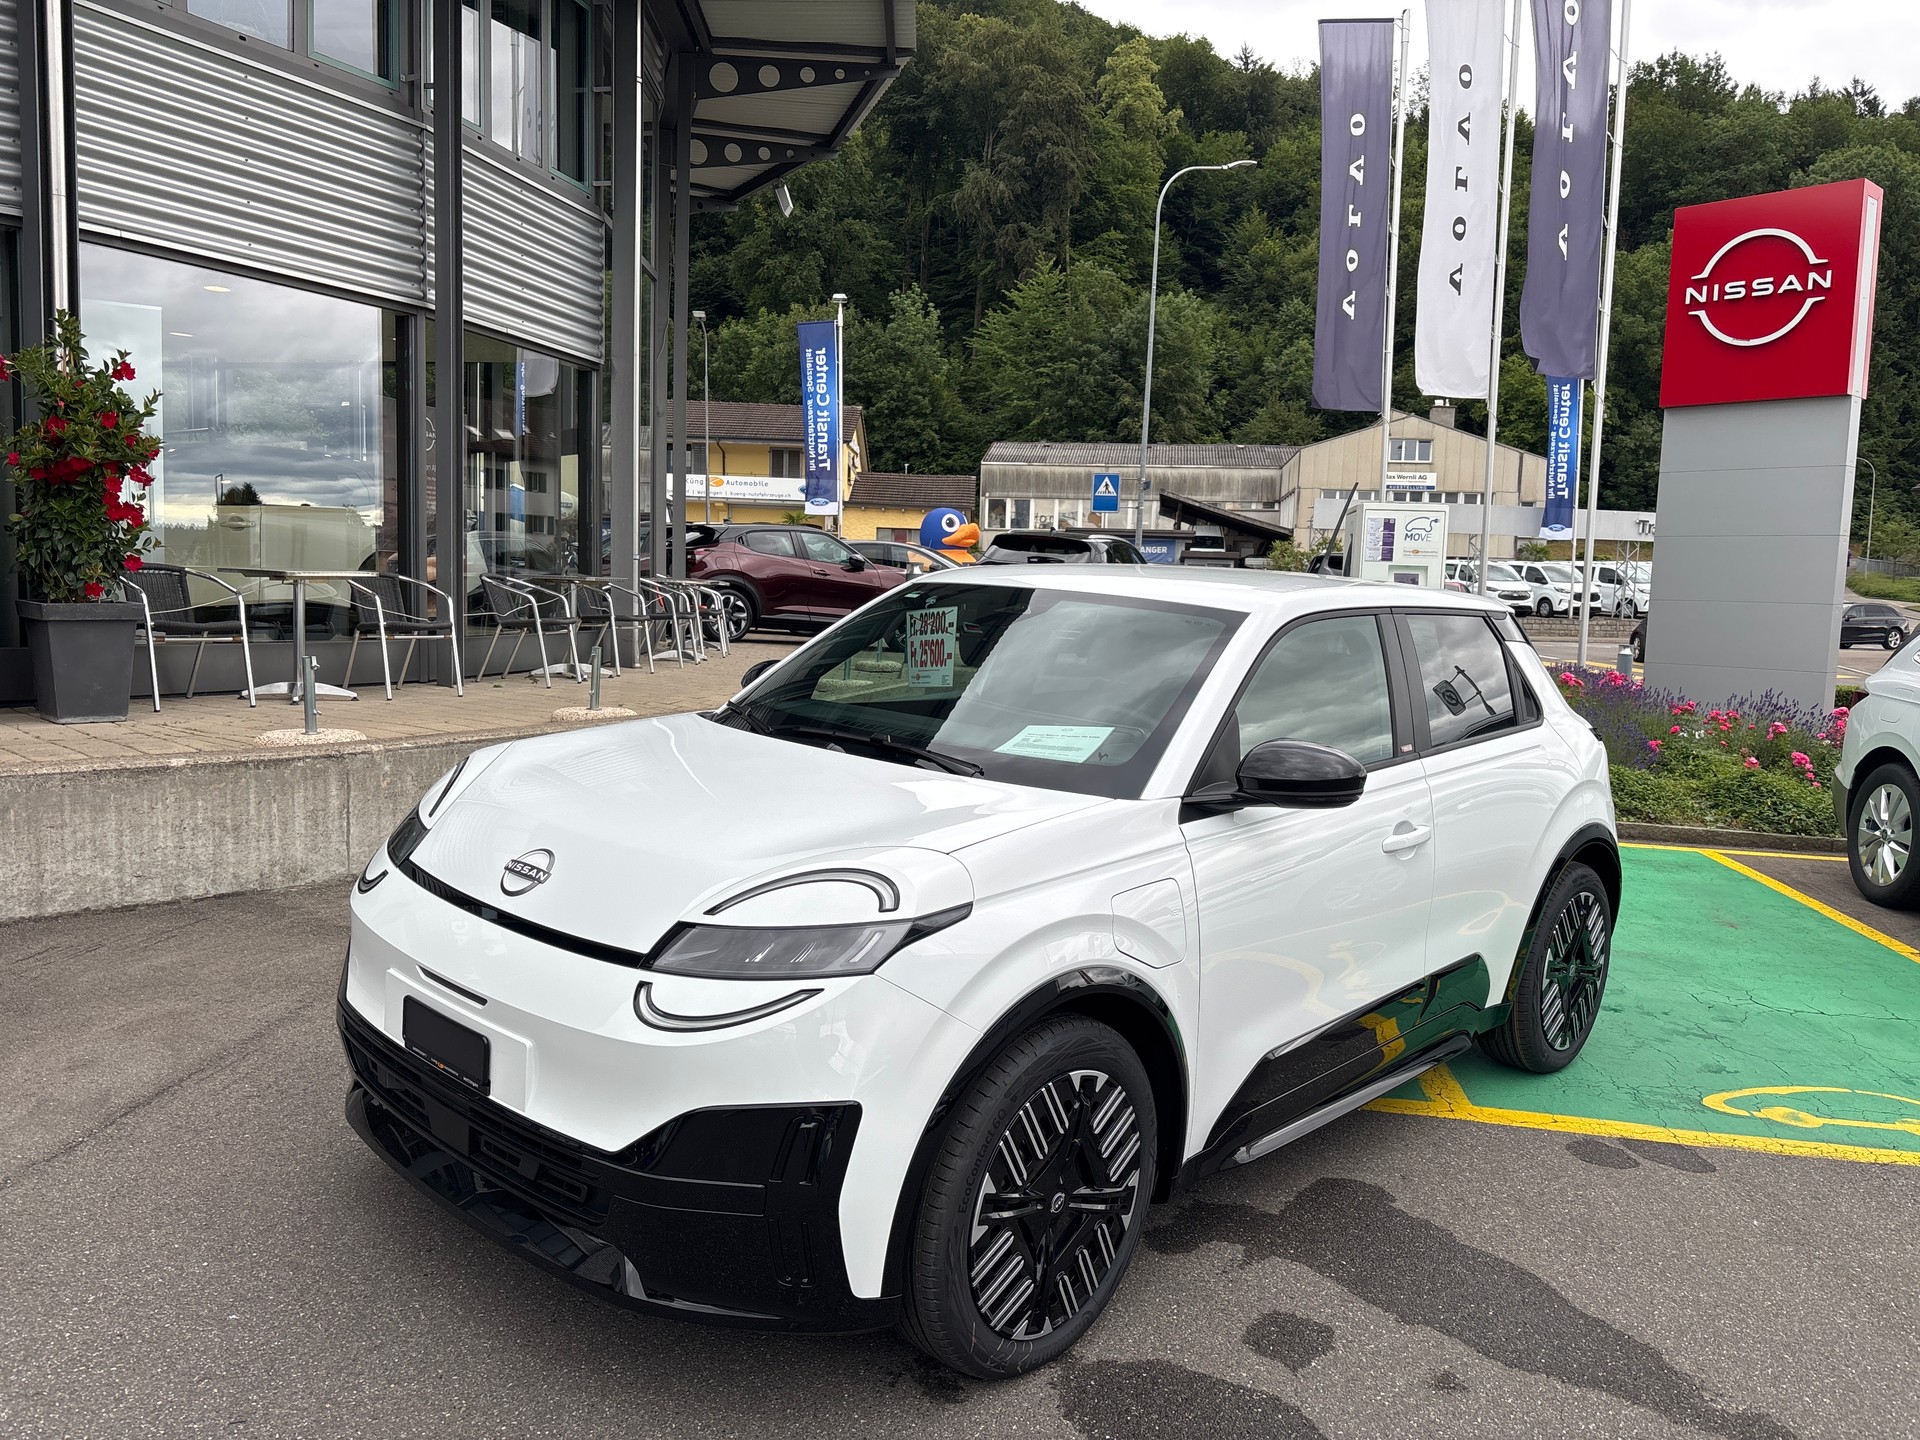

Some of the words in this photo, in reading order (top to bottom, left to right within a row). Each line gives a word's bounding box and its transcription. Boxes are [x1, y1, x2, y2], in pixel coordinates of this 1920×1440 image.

[1685, 270, 1832, 305] NISSAN
[1404, 532, 1433, 542] MOVE
[1140, 546, 1168, 554] ANGER
[910, 640, 919, 668] Fr.
[505, 860, 549, 881] NISSAN
[958, 1129, 995, 1214] EcoContact
